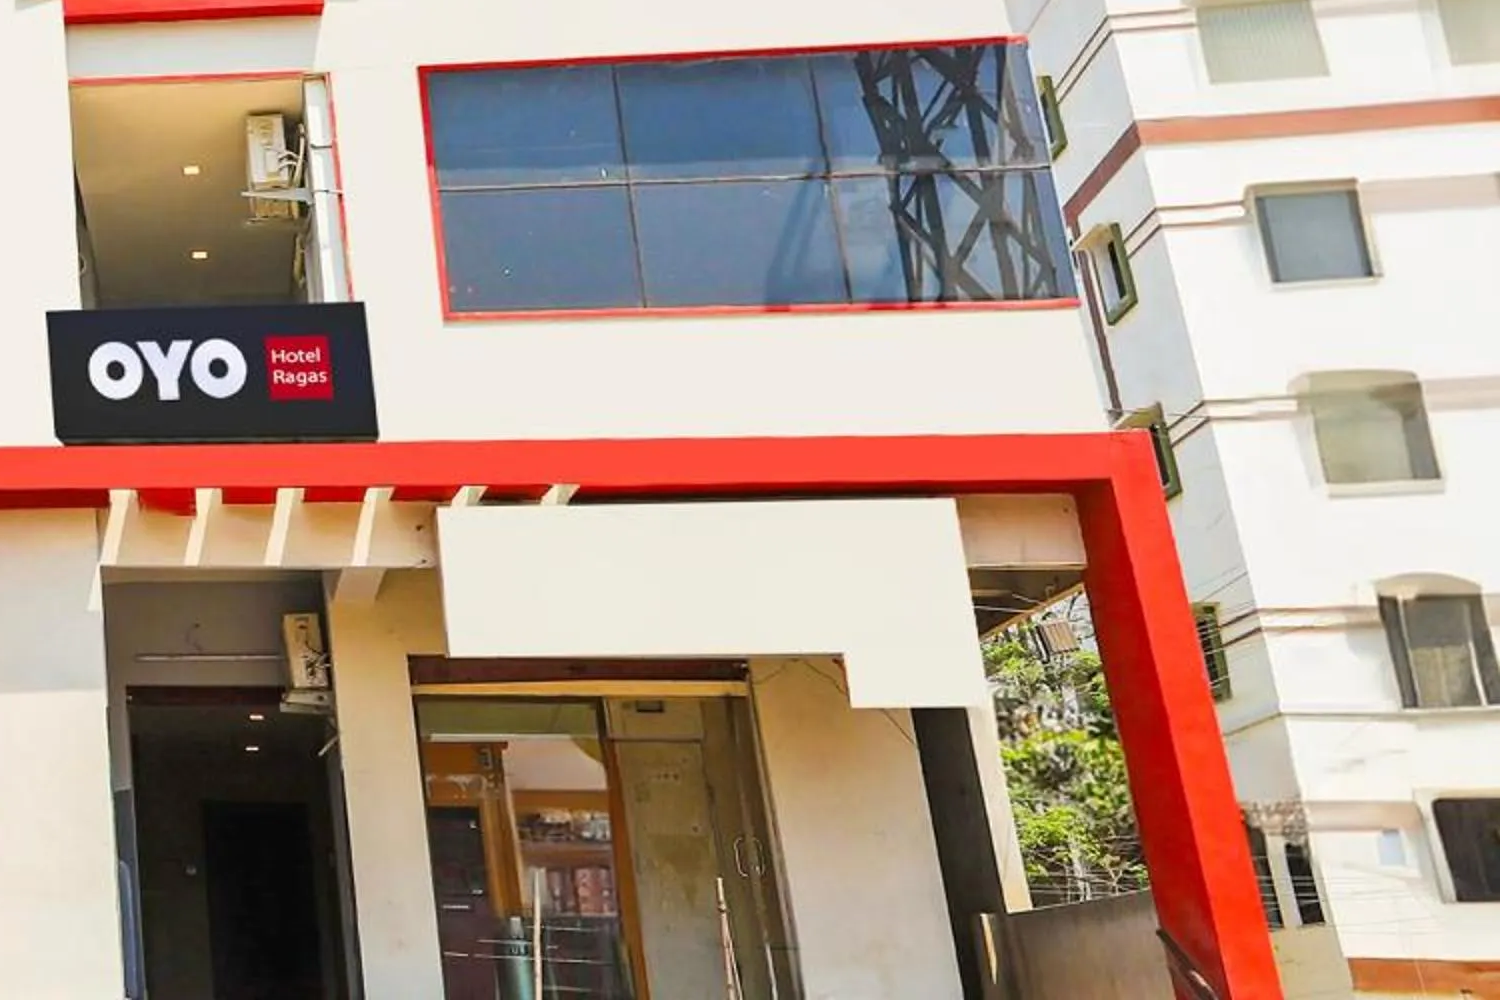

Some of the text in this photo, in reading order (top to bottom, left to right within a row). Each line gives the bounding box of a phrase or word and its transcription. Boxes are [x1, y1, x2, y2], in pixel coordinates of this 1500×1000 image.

[271, 347, 321, 364] Hotel
[88, 338, 248, 401] OYO
[273, 369, 328, 387] Ragas
